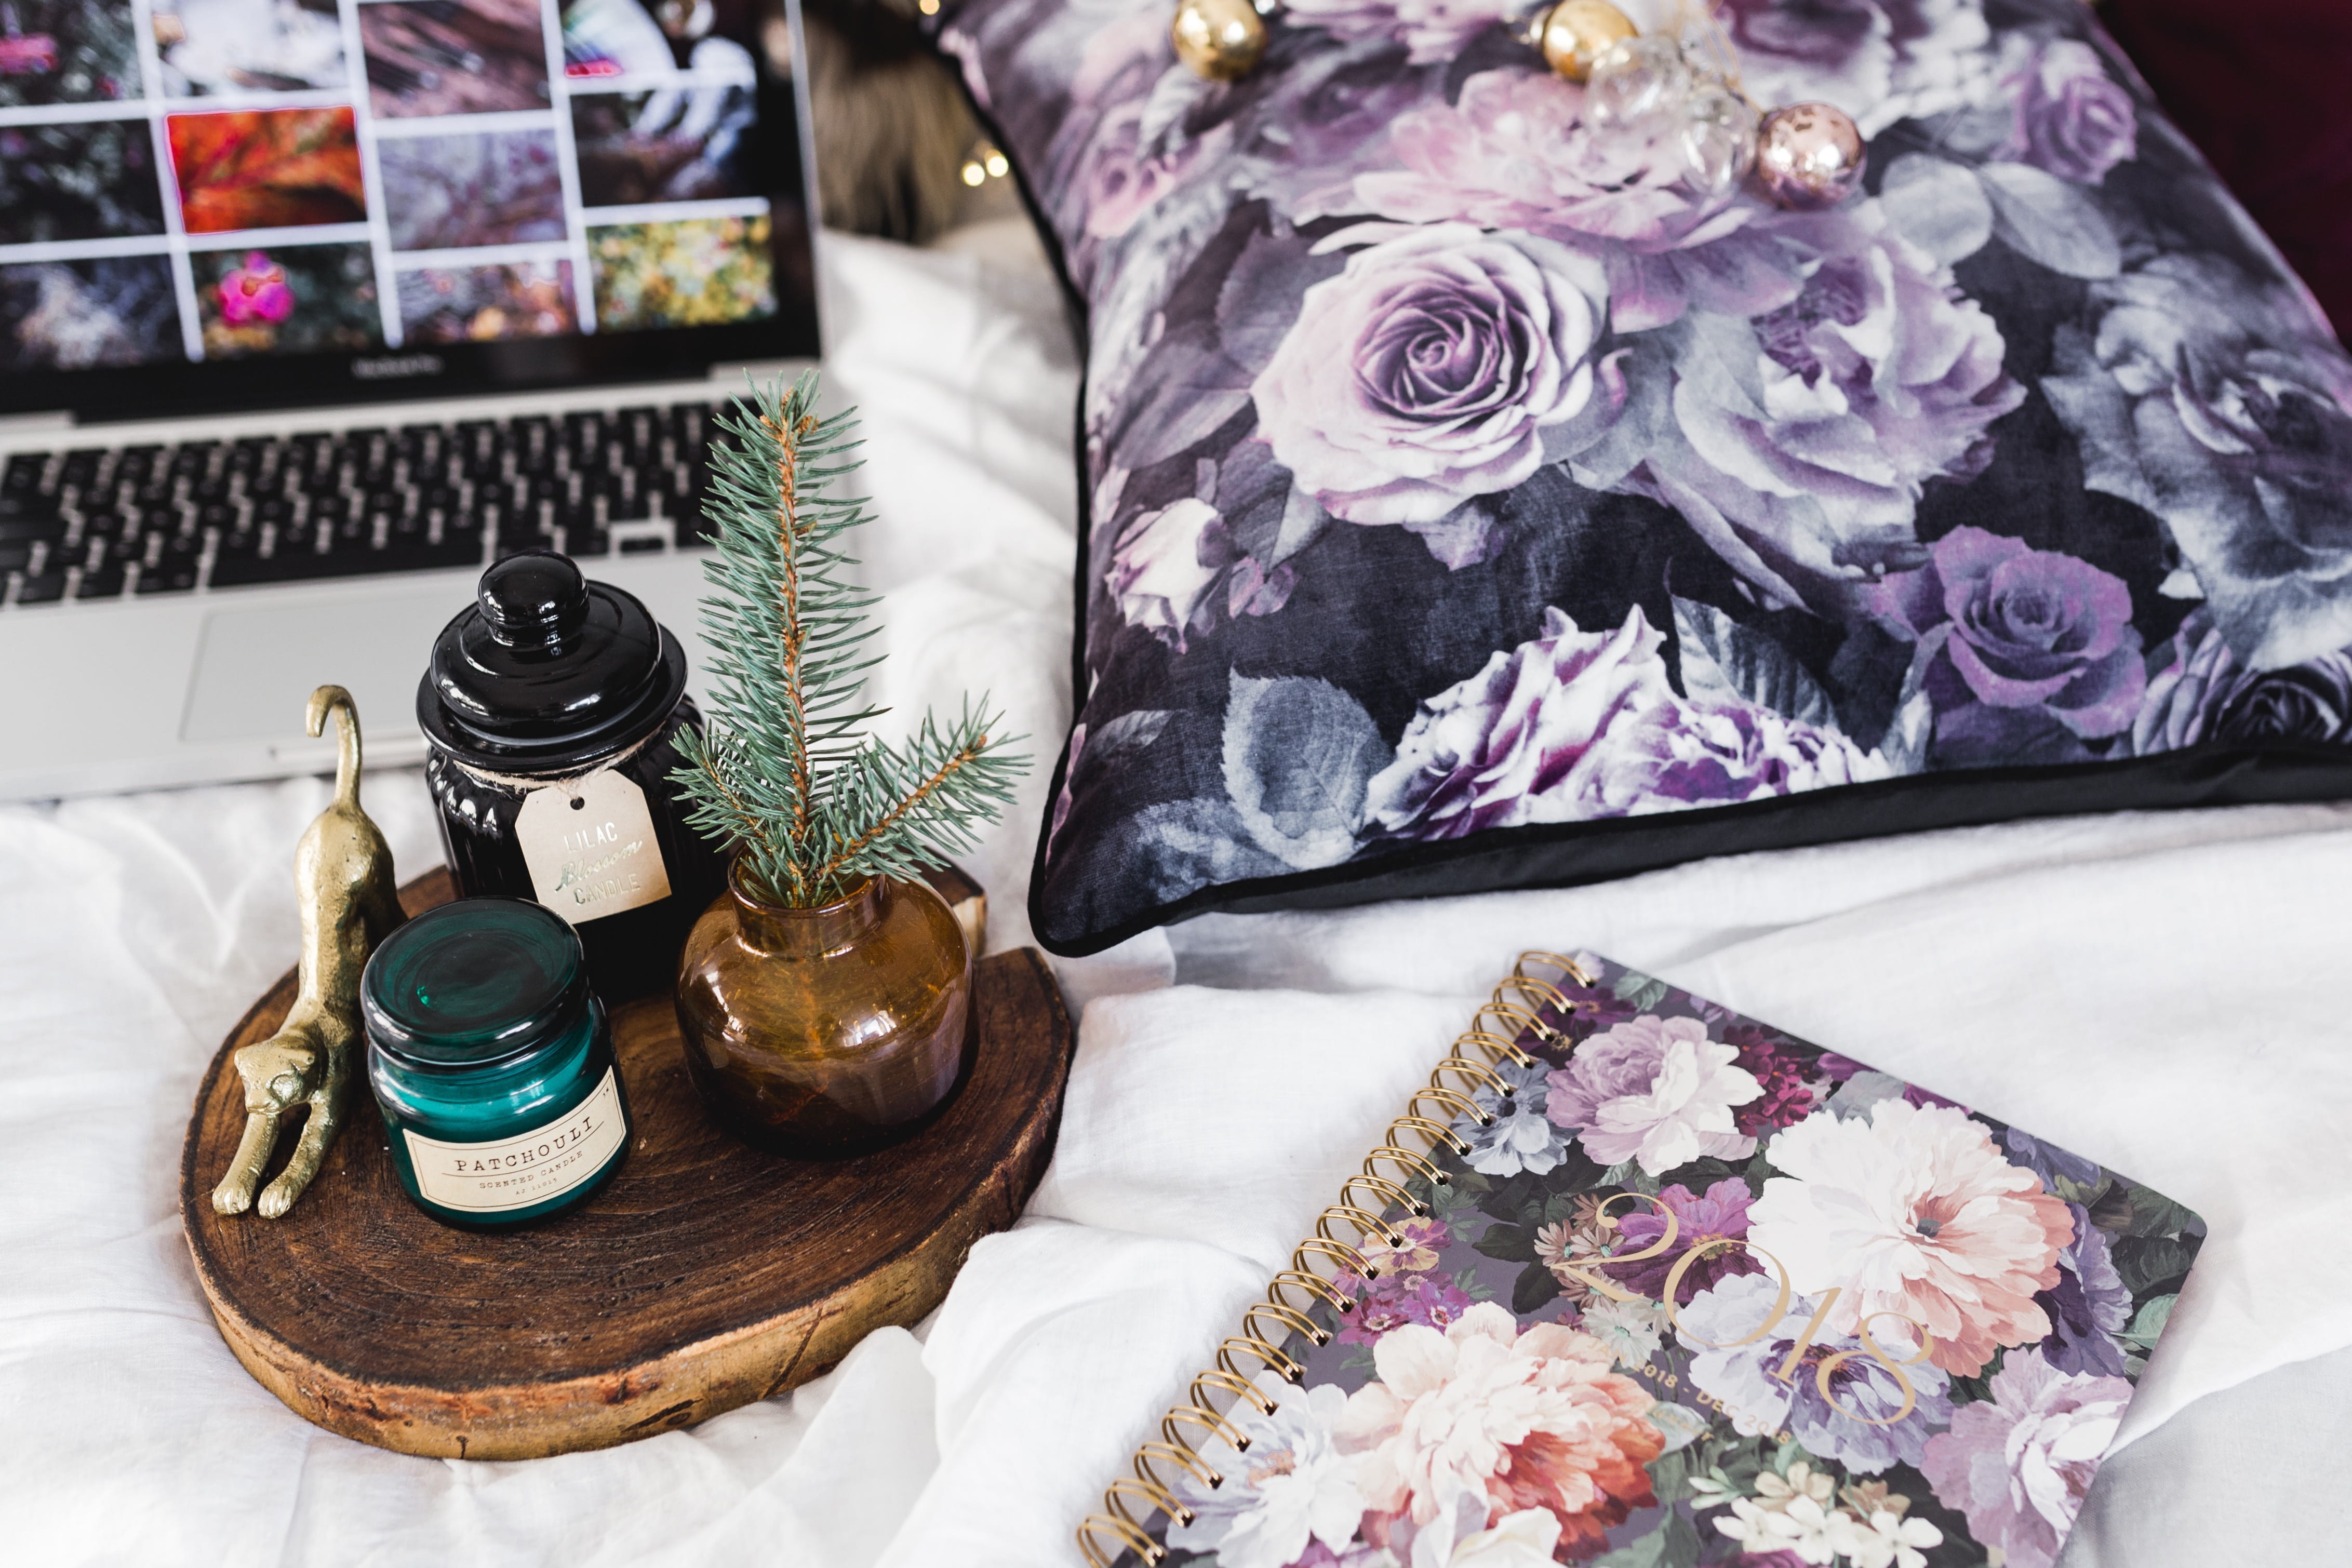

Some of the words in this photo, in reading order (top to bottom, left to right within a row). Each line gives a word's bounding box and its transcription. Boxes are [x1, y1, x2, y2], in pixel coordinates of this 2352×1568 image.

[564, 822, 618, 853] LILAC
[554, 840, 643, 893] Blossom
[573, 873, 641, 906] CANDLE
[455, 1116, 593, 1172] PATCHOULI
[479, 1174, 534, 1189] SCENTED
[540, 1151, 583, 1176] CANDLE
[1549, 1192, 1934, 1425] 2018
[1696, 1390, 1740, 1418] DEC
[1744, 1414, 1791, 1445] 2018
